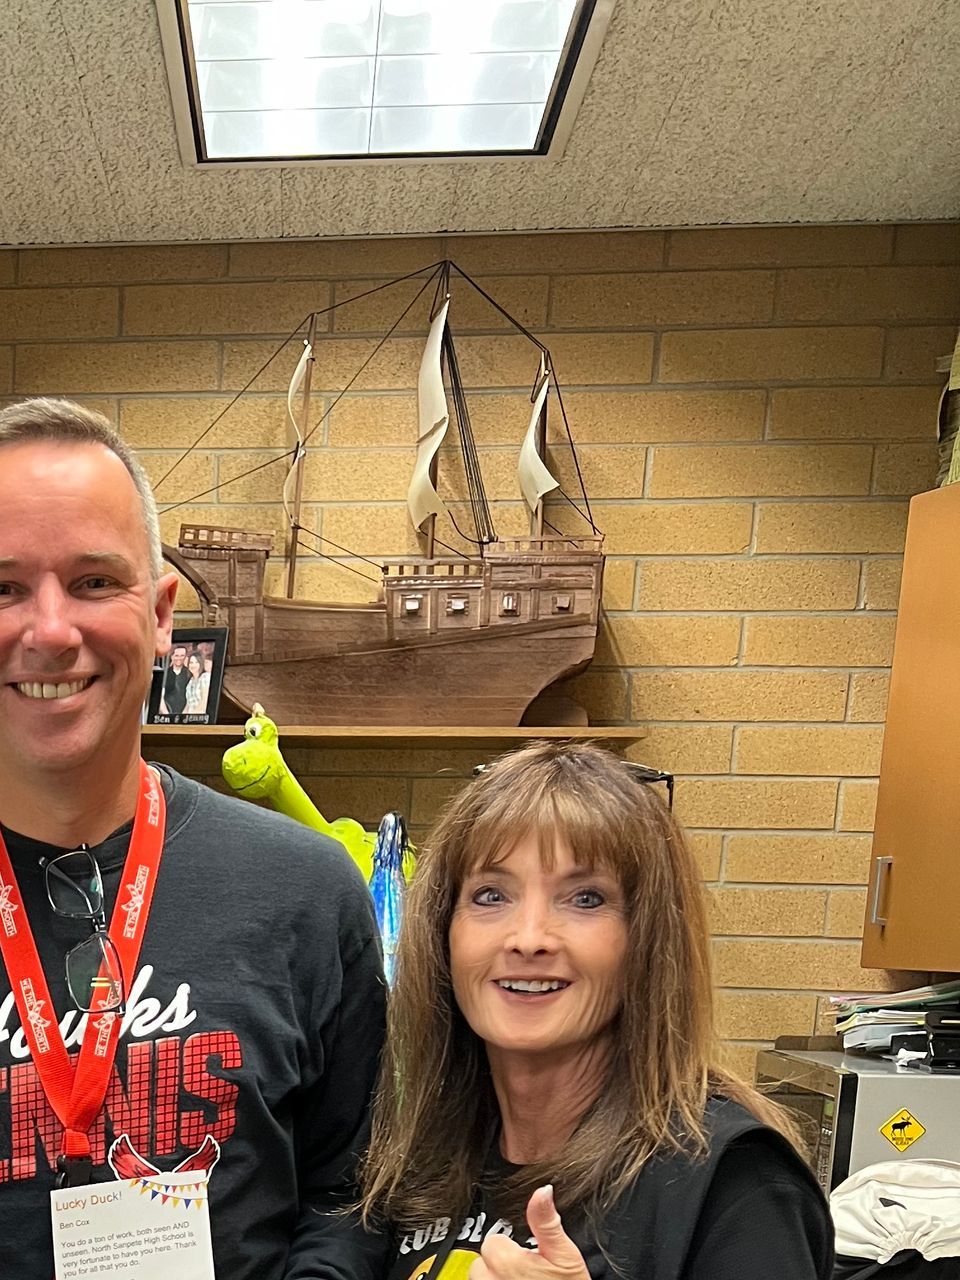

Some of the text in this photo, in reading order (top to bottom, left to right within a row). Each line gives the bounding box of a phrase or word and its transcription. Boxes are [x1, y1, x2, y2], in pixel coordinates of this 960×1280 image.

[153, 714, 171, 724] Ben
[182, 714, 210, 724] Jenny
[35, 1025, 49, 1053] NORTH
[55, 1191, 122, 1212] Lucky Duck!
[60, 1222, 74, 1230] Ben
[107, 1233, 114, 1241] of
[136, 1228, 152, 1236] both
[153, 1225, 171, 1233] seen
[172, 1221, 190, 1230] AND
[91, 1244, 112, 1253] North
[113, 1240, 143, 1249] Sanpete
[144, 1236, 161, 1245] High
[162, 1231, 187, 1242] School
[63, 1260, 78, 1268] very
[80, 1254, 112, 1265] fortunate
[112, 1252, 120, 1260] to
[121, 1249, 139, 1258] have
[140, 1247, 154, 1257] you
[174, 1240, 197, 1249] Thank
[64, 1270, 77, 1279] you
[79, 1267, 89, 1275] for
[90, 1265, 99, 1273] all
[99, 1262, 113, 1271] that
[114, 1261, 128, 1270] you
